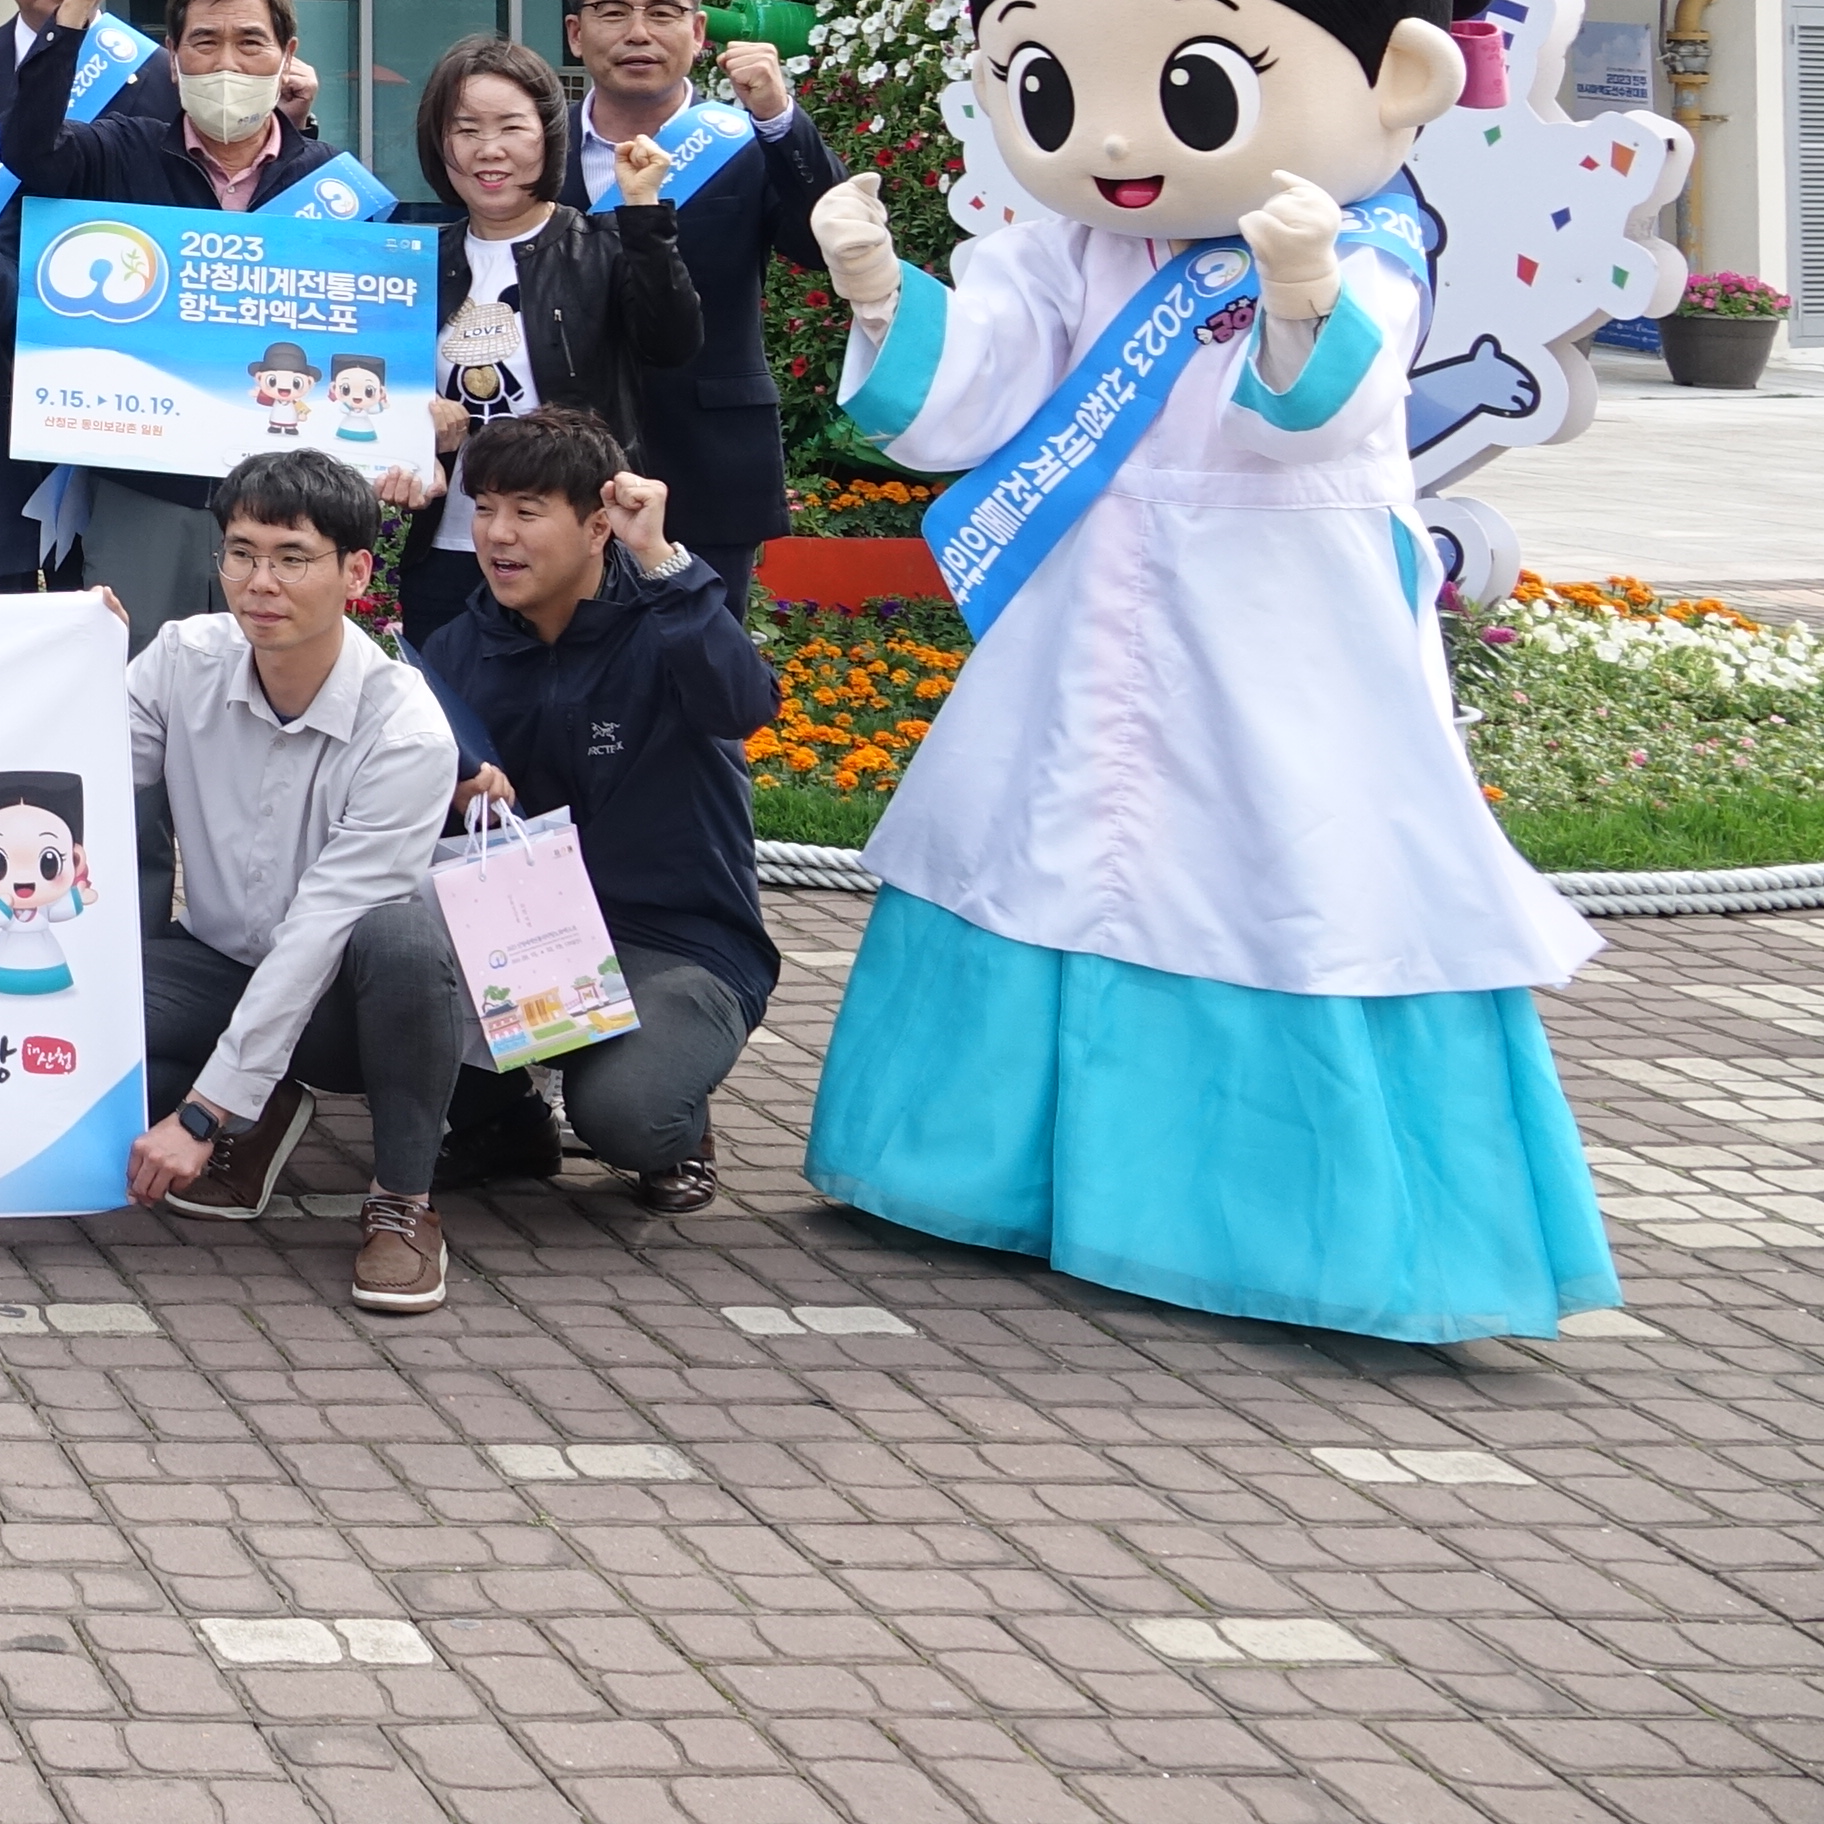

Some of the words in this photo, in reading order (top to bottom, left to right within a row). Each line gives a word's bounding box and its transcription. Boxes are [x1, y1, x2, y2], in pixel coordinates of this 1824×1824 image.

[180, 231, 264, 262] 2023
[179, 264, 418, 308] 산청세계전통의약
[178, 293, 359, 335] 항노화엑스포
[463, 323, 504, 339] LOVE
[1121, 282, 1198, 379] 2023
[35, 386, 91, 411] 9.15.
[114, 392, 181, 417] 10.19.
[44, 414, 79, 432] 산청군
[81, 417, 137, 435] 동의보감촌
[140, 419, 164, 436] 일원
[26, 1043, 41, 1056] in
[36, 1046, 72, 1070] 산청
